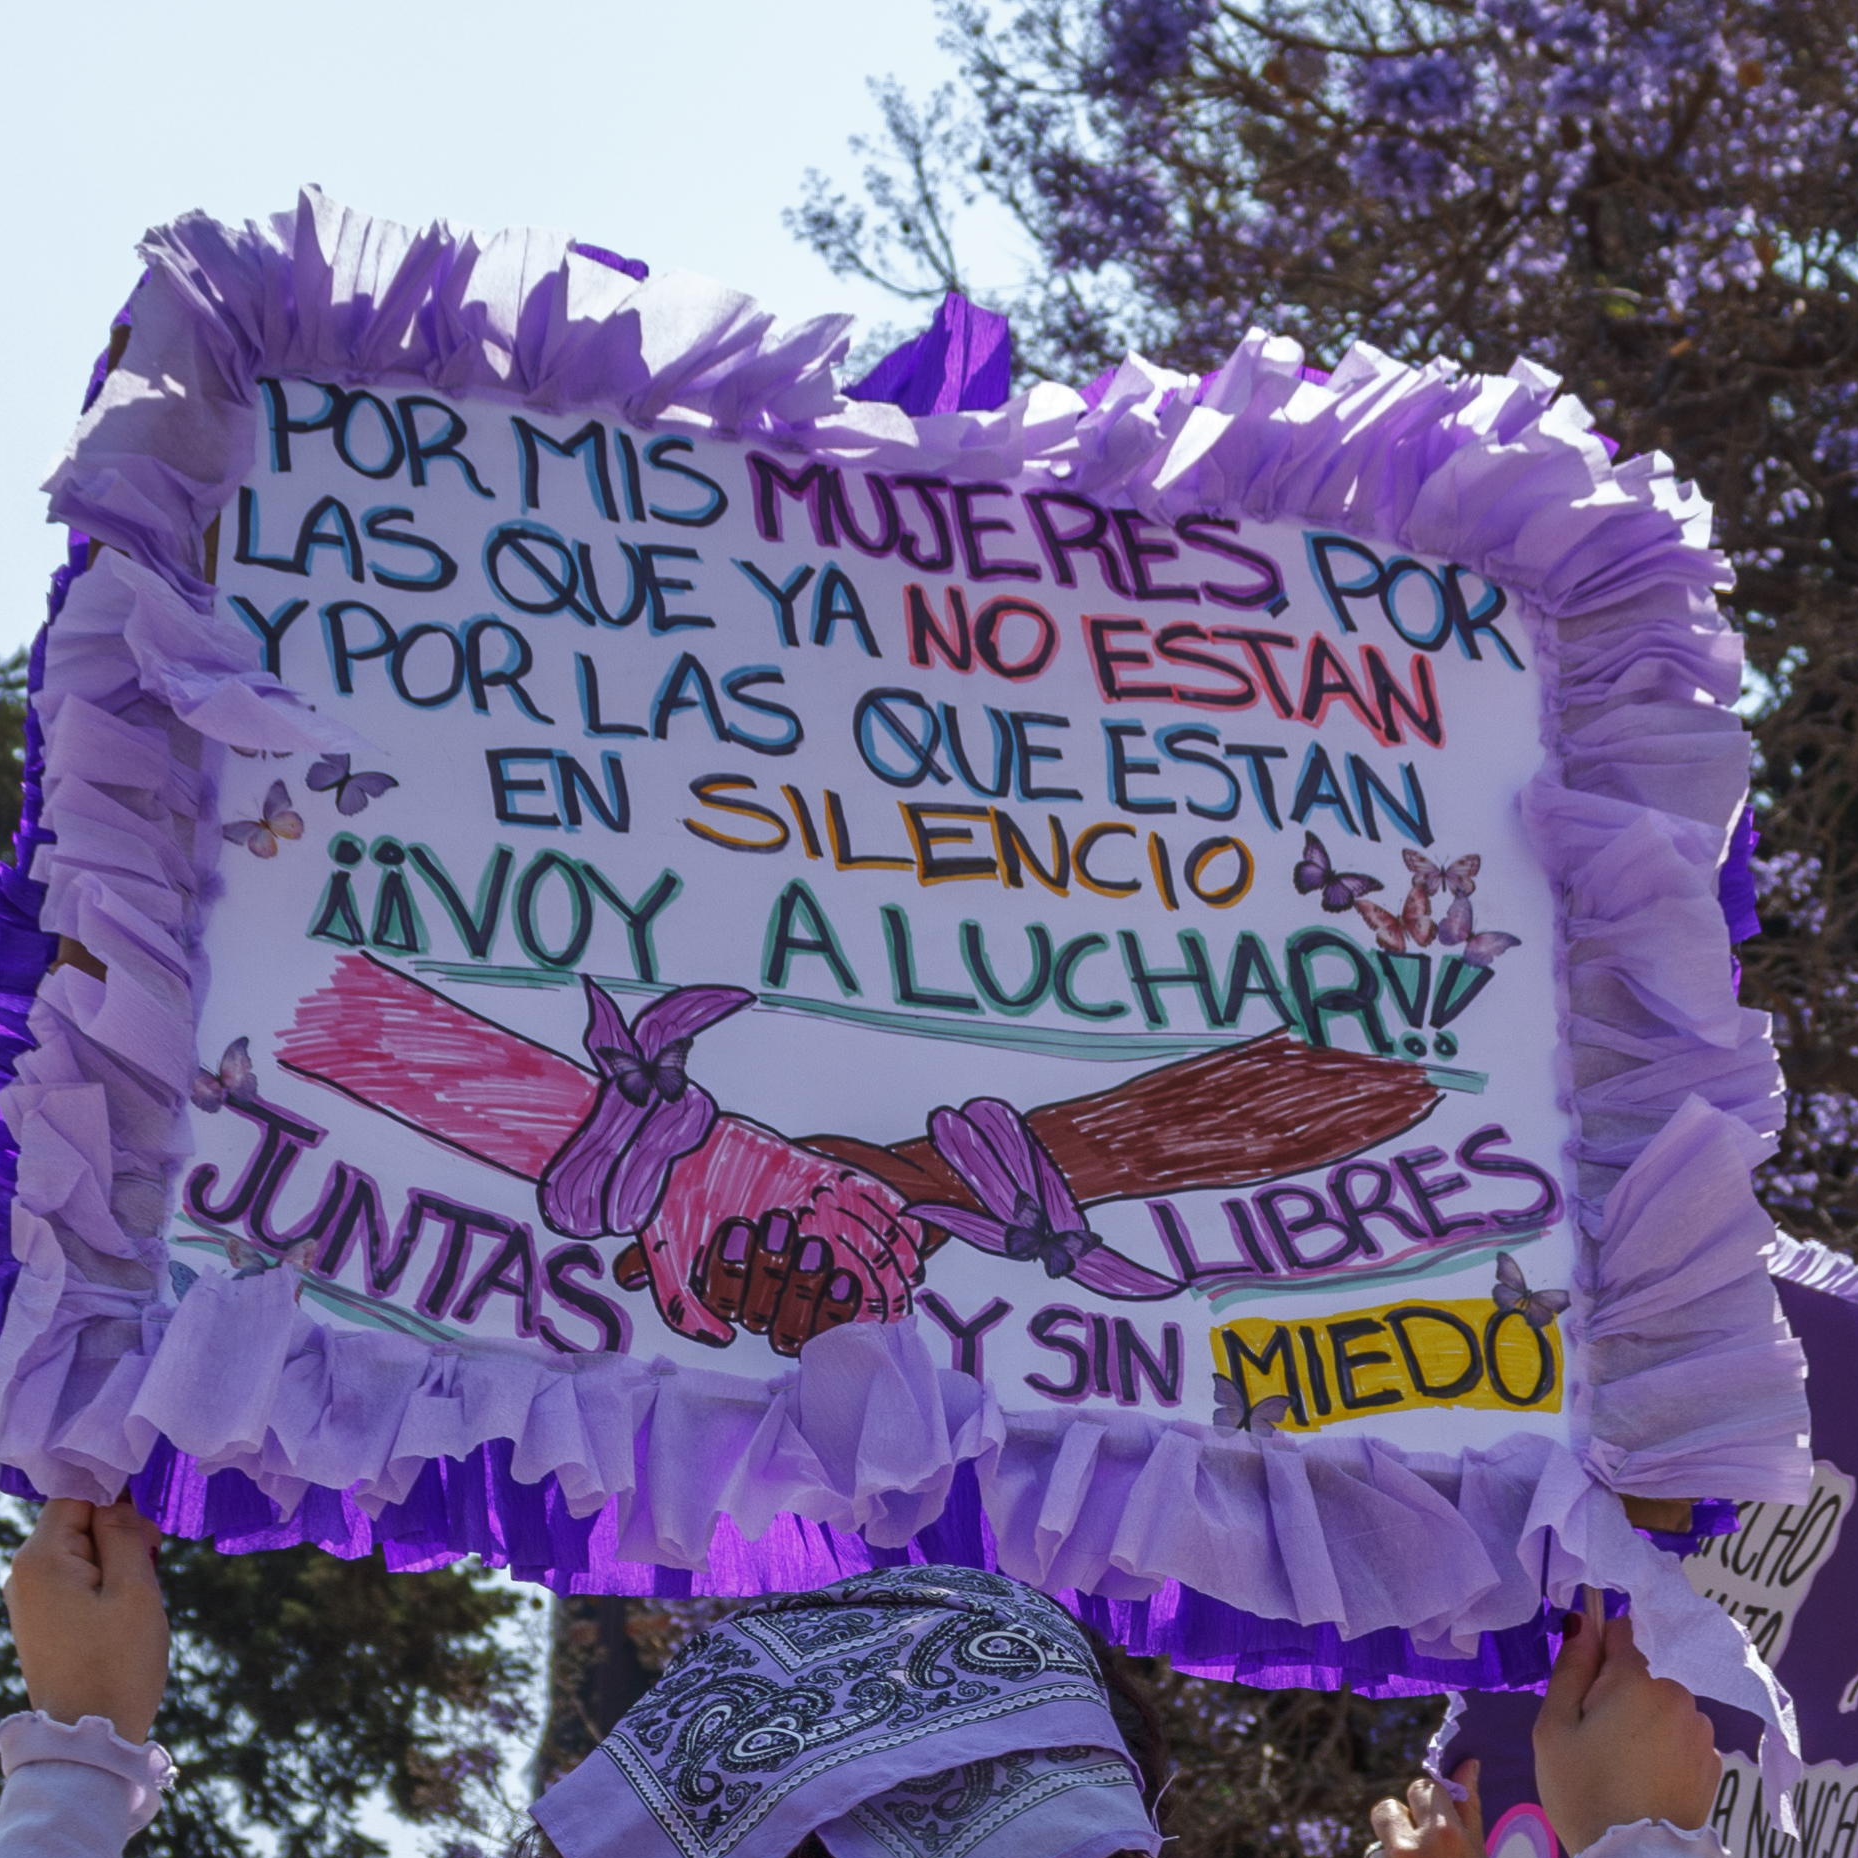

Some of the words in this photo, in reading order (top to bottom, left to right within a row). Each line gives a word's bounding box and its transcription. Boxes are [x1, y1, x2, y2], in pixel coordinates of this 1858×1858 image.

[234, 487, 457, 591] LAS
[484, 525, 717, 632] QUE
[733, 558, 882, 658] YA
[904, 586, 1057, 680] NO
[1084, 616, 1443, 747] ESTAN
[261, 378, 495, 496] POR
[513, 415, 727, 525] MIS
[1304, 532, 1526, 670] POR
[229, 596, 311, 681] Y
[325, 602, 553, 725] POR
[579, 653, 804, 753] LAS
[853, 687, 1082, 800] QUE
[1104, 722, 1434, 848] ESTAN
[486, 749, 629, 832] EN
[684, 774, 1253, 908] SILENCIO
[762, 881, 860, 996] A
[882, 904, 1496, 1058] LUCHAR!!
[186, 1094, 631, 1353] JUNTAS
[1149, 1127, 1560, 1280] LIBRES
[921, 1290, 1011, 1382] Y
[1025, 1304, 1184, 1406] SIN
[1217, 1304, 1557, 1429] MIEDO
